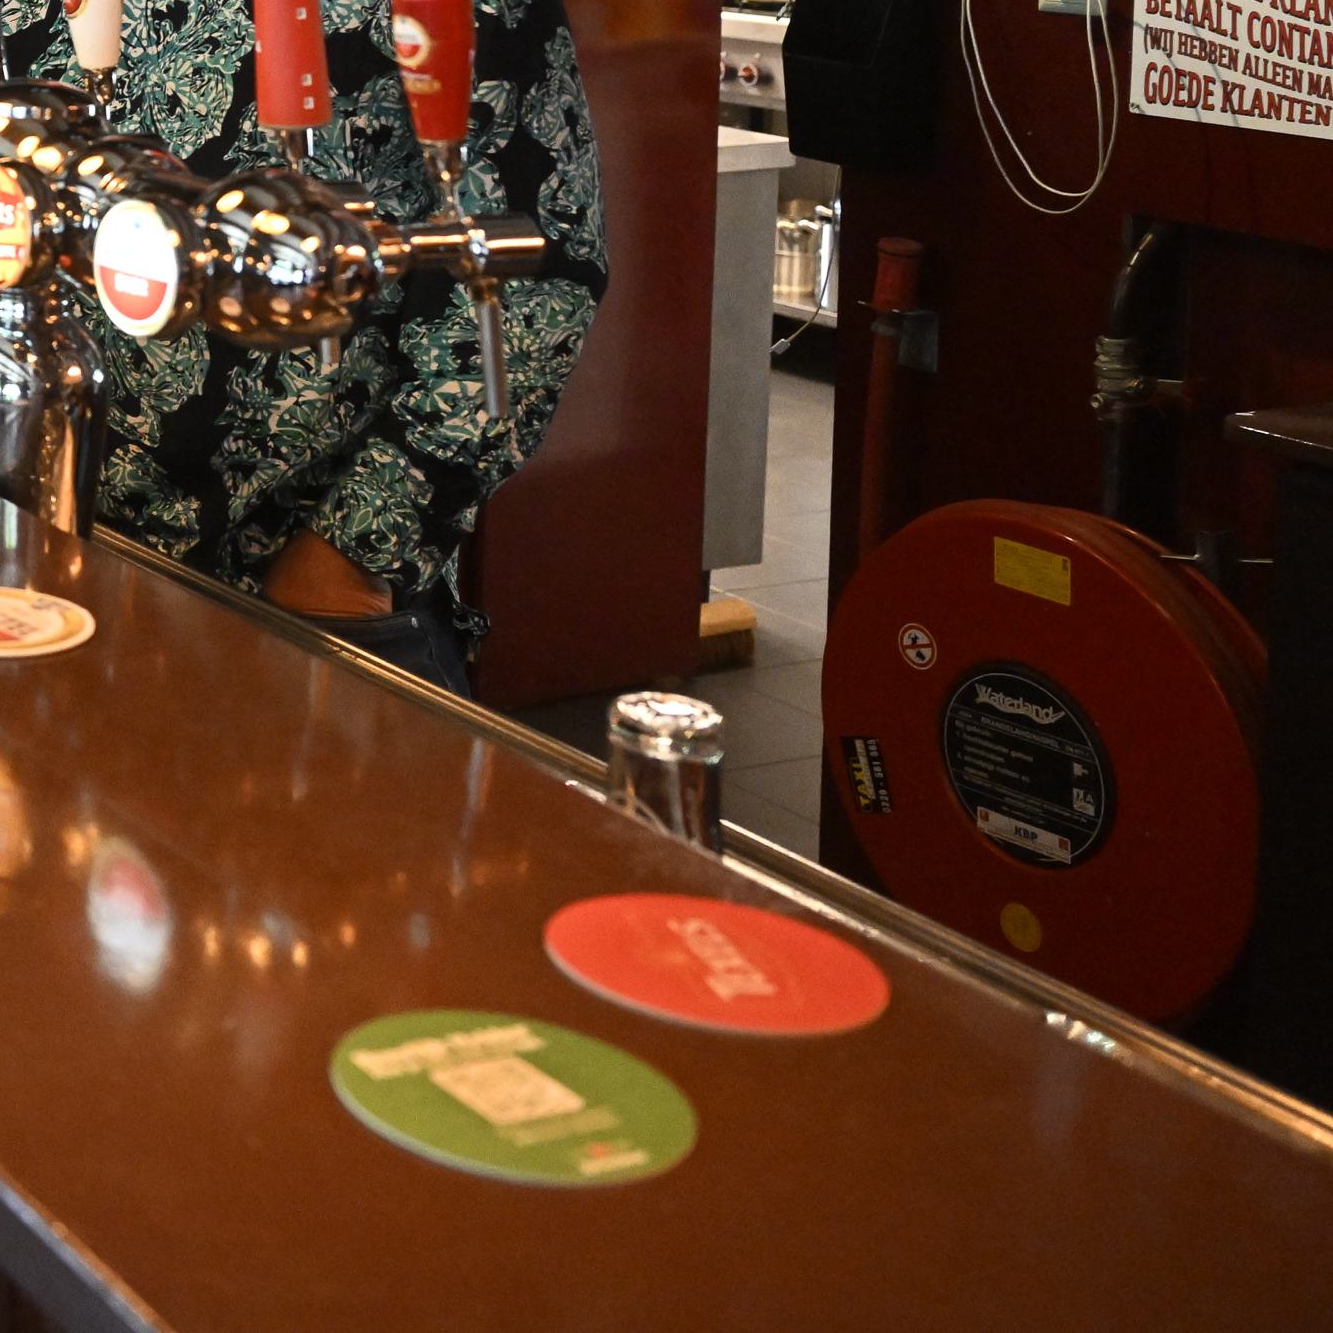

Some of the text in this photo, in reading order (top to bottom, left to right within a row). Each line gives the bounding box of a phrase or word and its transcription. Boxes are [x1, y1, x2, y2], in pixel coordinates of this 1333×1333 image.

[1177, 32, 1240, 73] HEBBEN
[1241, 53, 1304, 95] ALLEEN
[1144, 62, 1332, 128] GOEDE KLANTEN
[974, 683, 1054, 721] Waterland
[852, 762, 870, 807] TAXI
